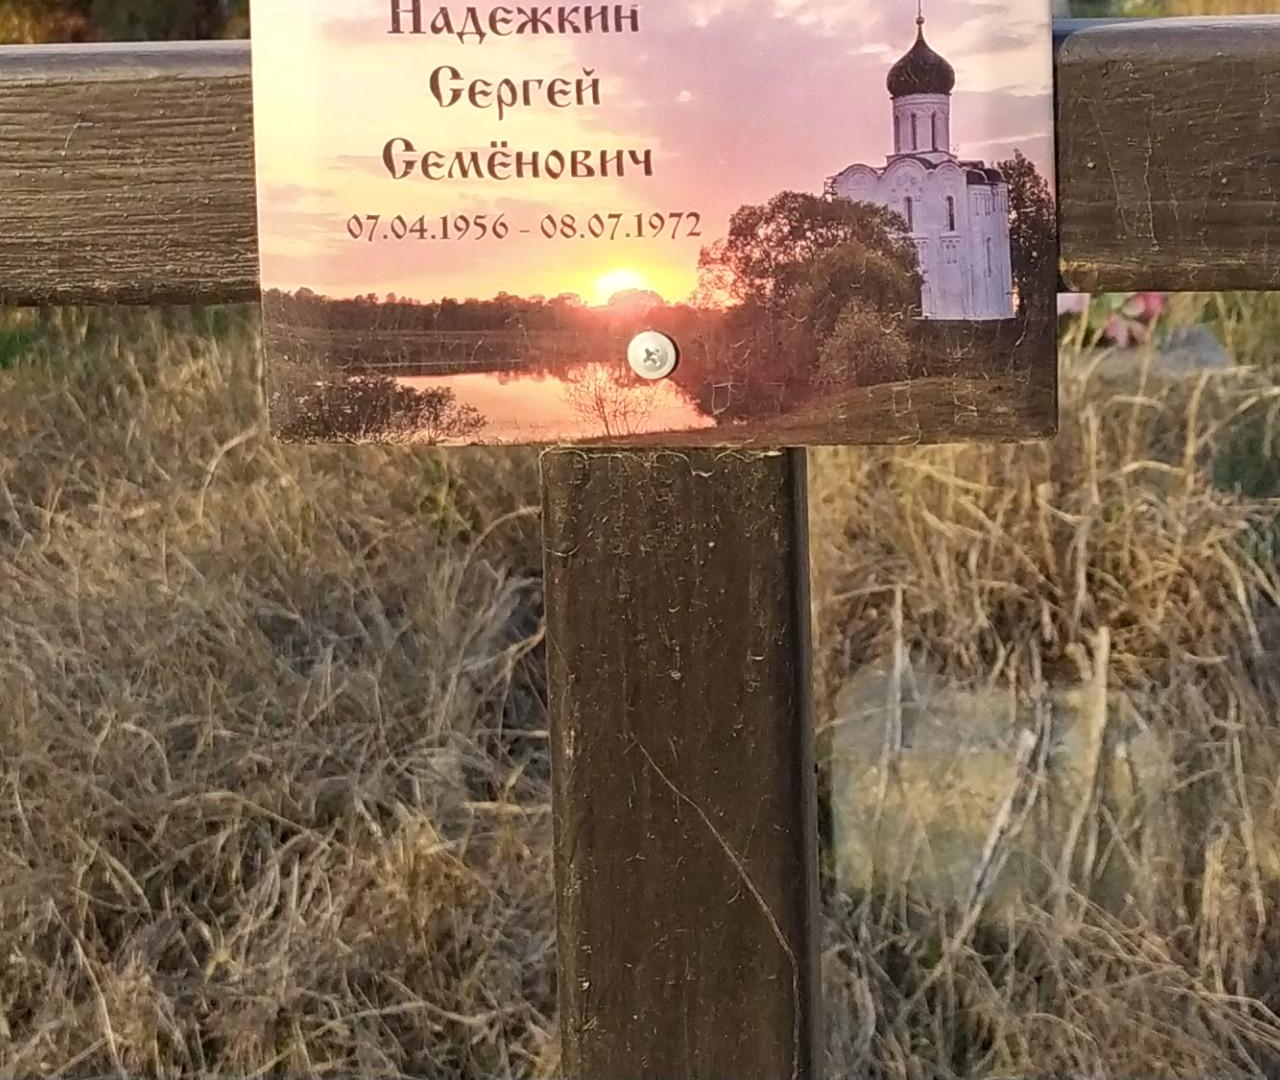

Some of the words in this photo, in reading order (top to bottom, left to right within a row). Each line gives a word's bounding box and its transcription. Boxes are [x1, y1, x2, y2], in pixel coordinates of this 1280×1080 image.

[428, 65, 602, 121] Сергей
[381, 136, 654, 180] Семёнович
[346, 212, 510, 242] 07.04.1956
[540, 211, 703, 241] 08.07.1972
